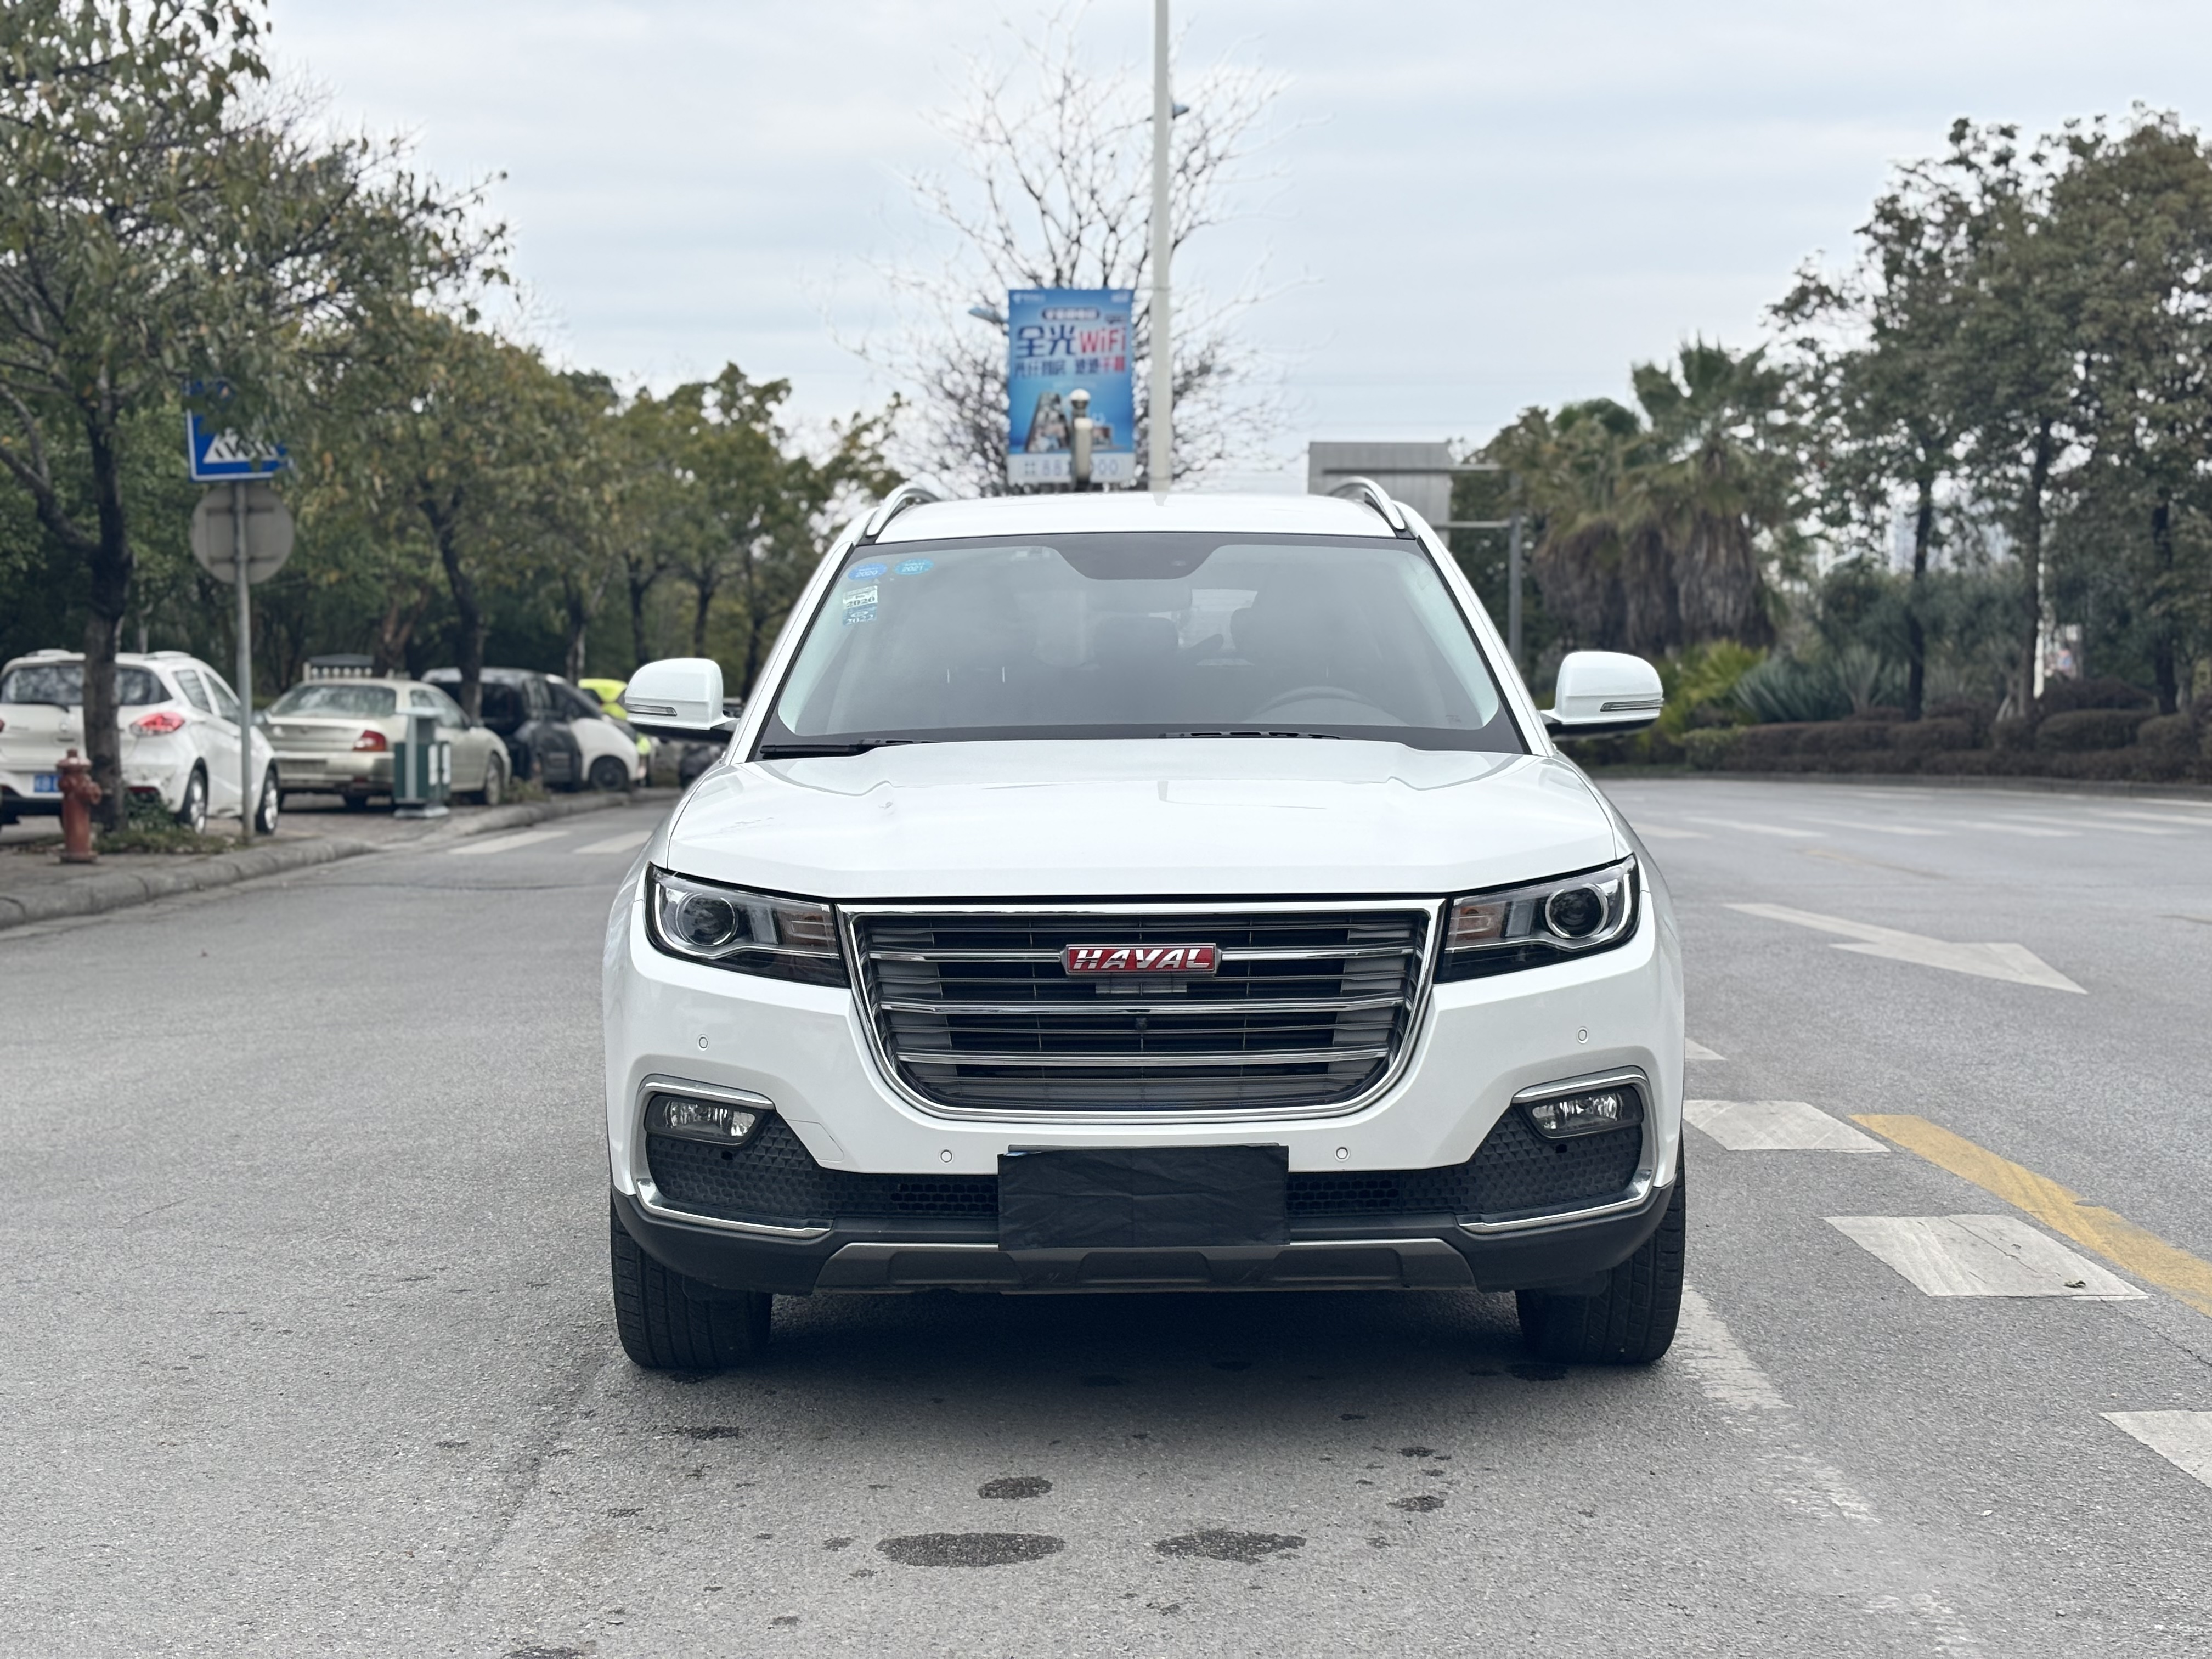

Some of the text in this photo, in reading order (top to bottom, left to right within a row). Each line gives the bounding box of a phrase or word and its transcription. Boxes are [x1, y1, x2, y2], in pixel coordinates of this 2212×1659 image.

[855, 569, 878, 578] 2020
[846, 596, 876, 608] 2020
[846, 614, 874, 625] 2022
[1073, 949, 1210, 969] HAVAL
